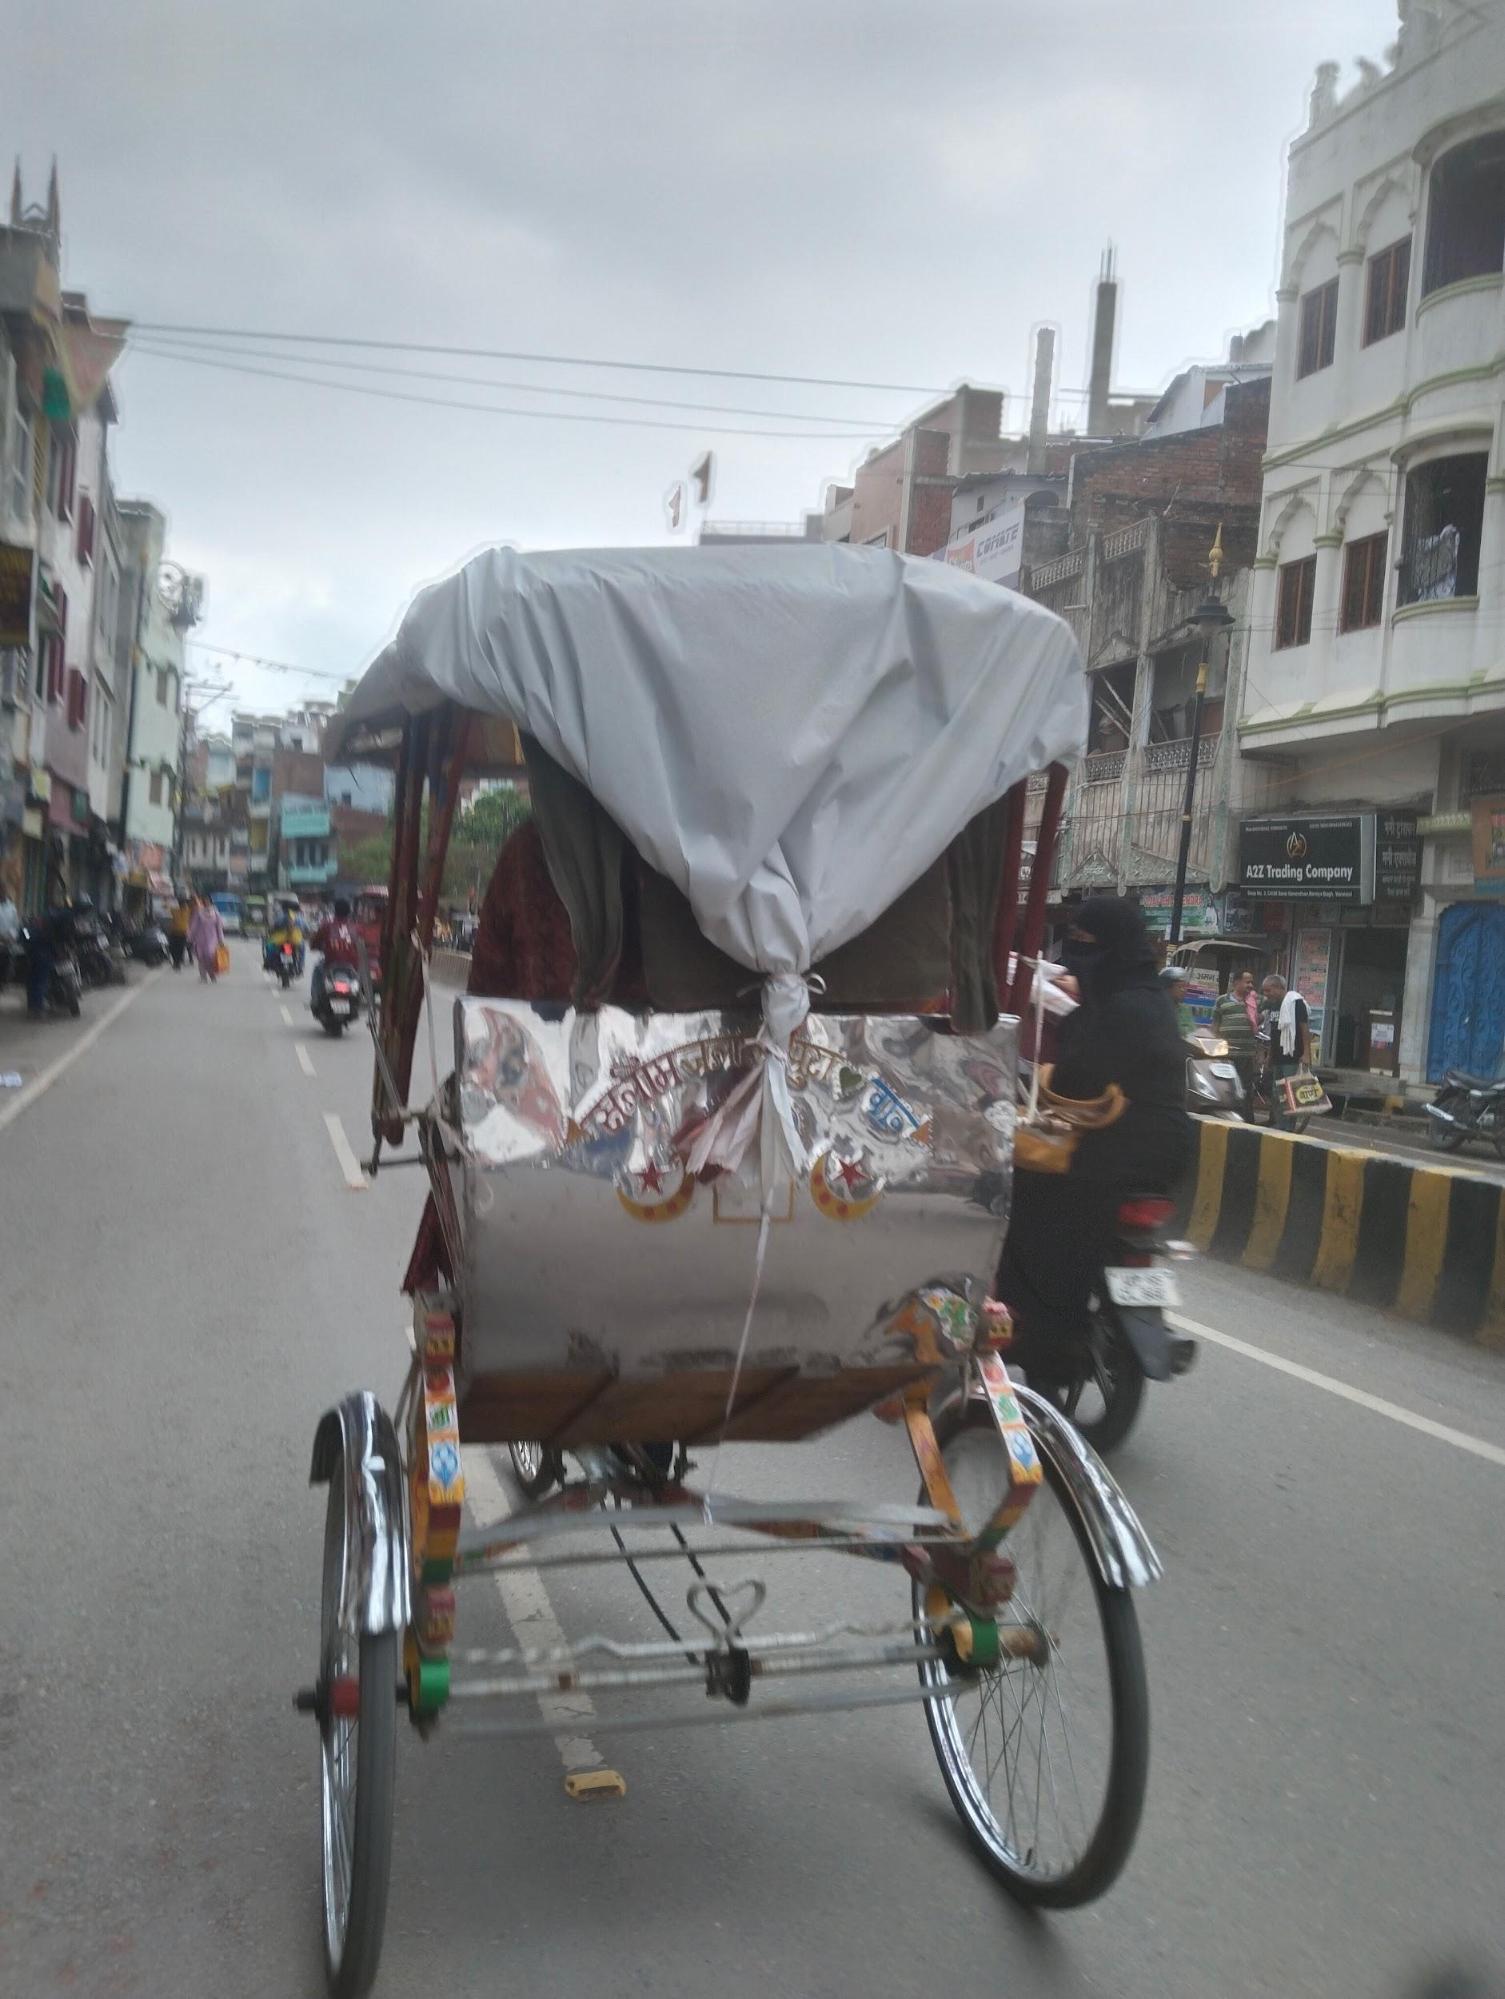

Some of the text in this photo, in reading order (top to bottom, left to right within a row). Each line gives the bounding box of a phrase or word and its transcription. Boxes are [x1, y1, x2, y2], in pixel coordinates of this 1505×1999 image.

[1246, 863, 1353, 881] A2Z Trading Company
